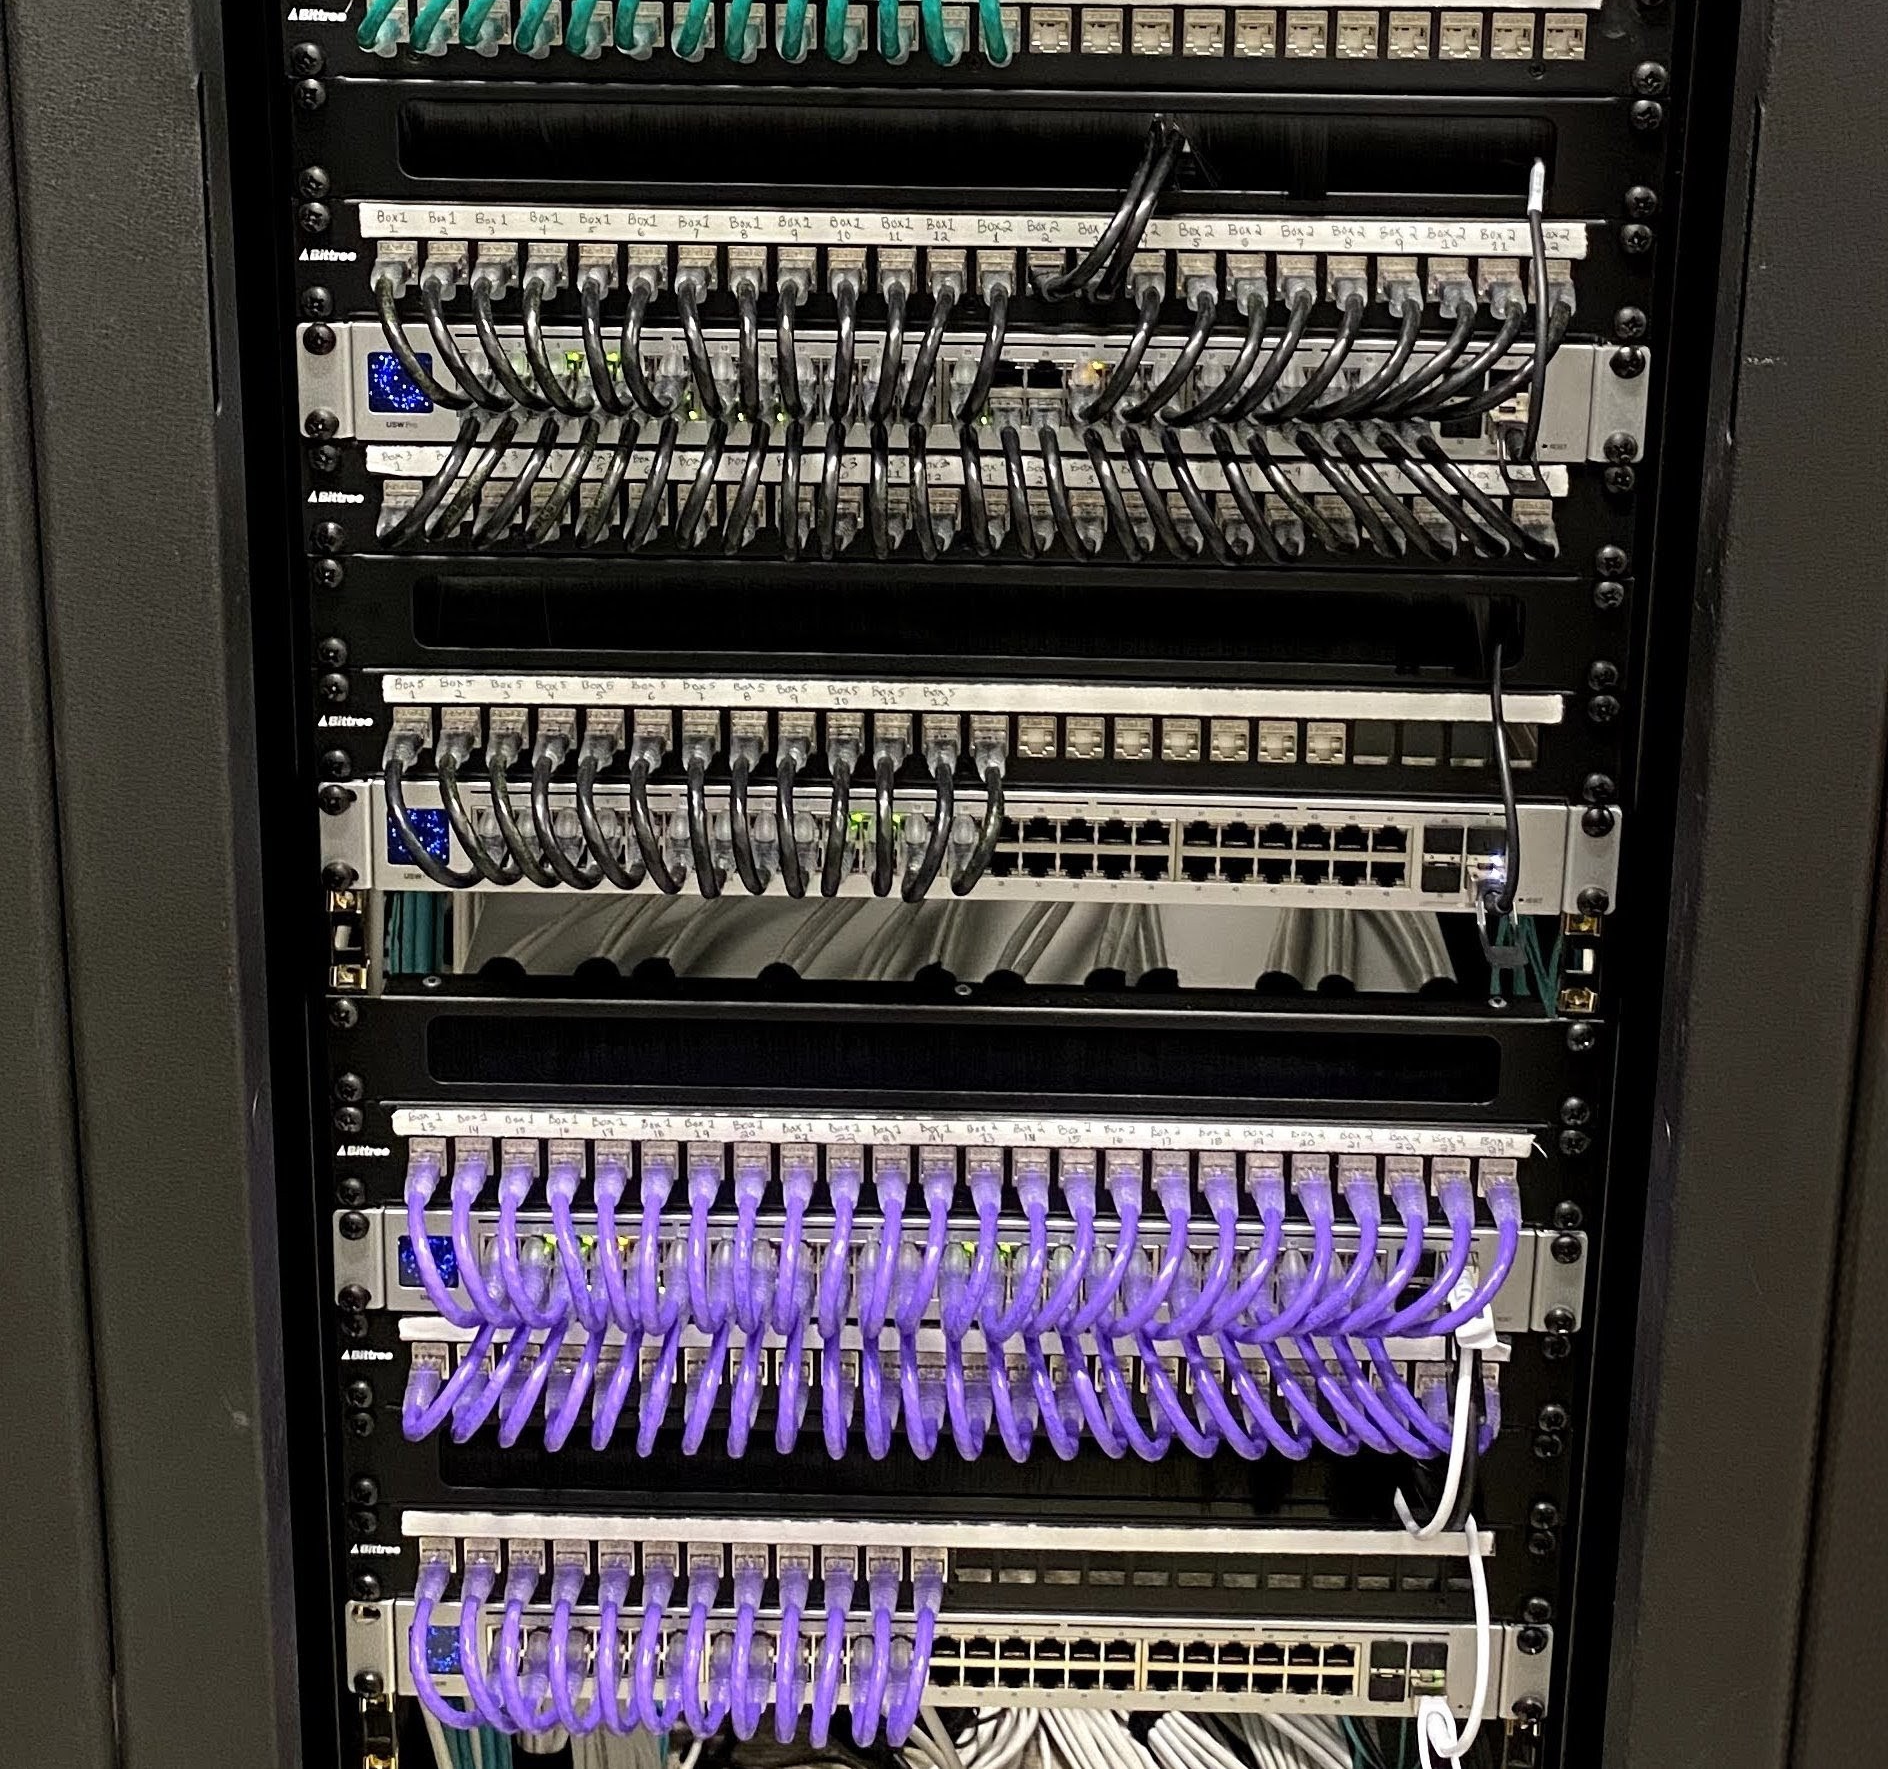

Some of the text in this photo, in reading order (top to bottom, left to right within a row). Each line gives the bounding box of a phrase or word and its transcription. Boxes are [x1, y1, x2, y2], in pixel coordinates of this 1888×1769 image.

[299, 8, 347, 22] Bittree
[837, 230, 850, 242] 10
[934, 232, 950, 242] 12
[309, 248, 357, 262] Bittree
[320, 491, 365, 505] Bittree
[328, 715, 374, 728] Bittree
[347, 1146, 390, 1158] Bittree
